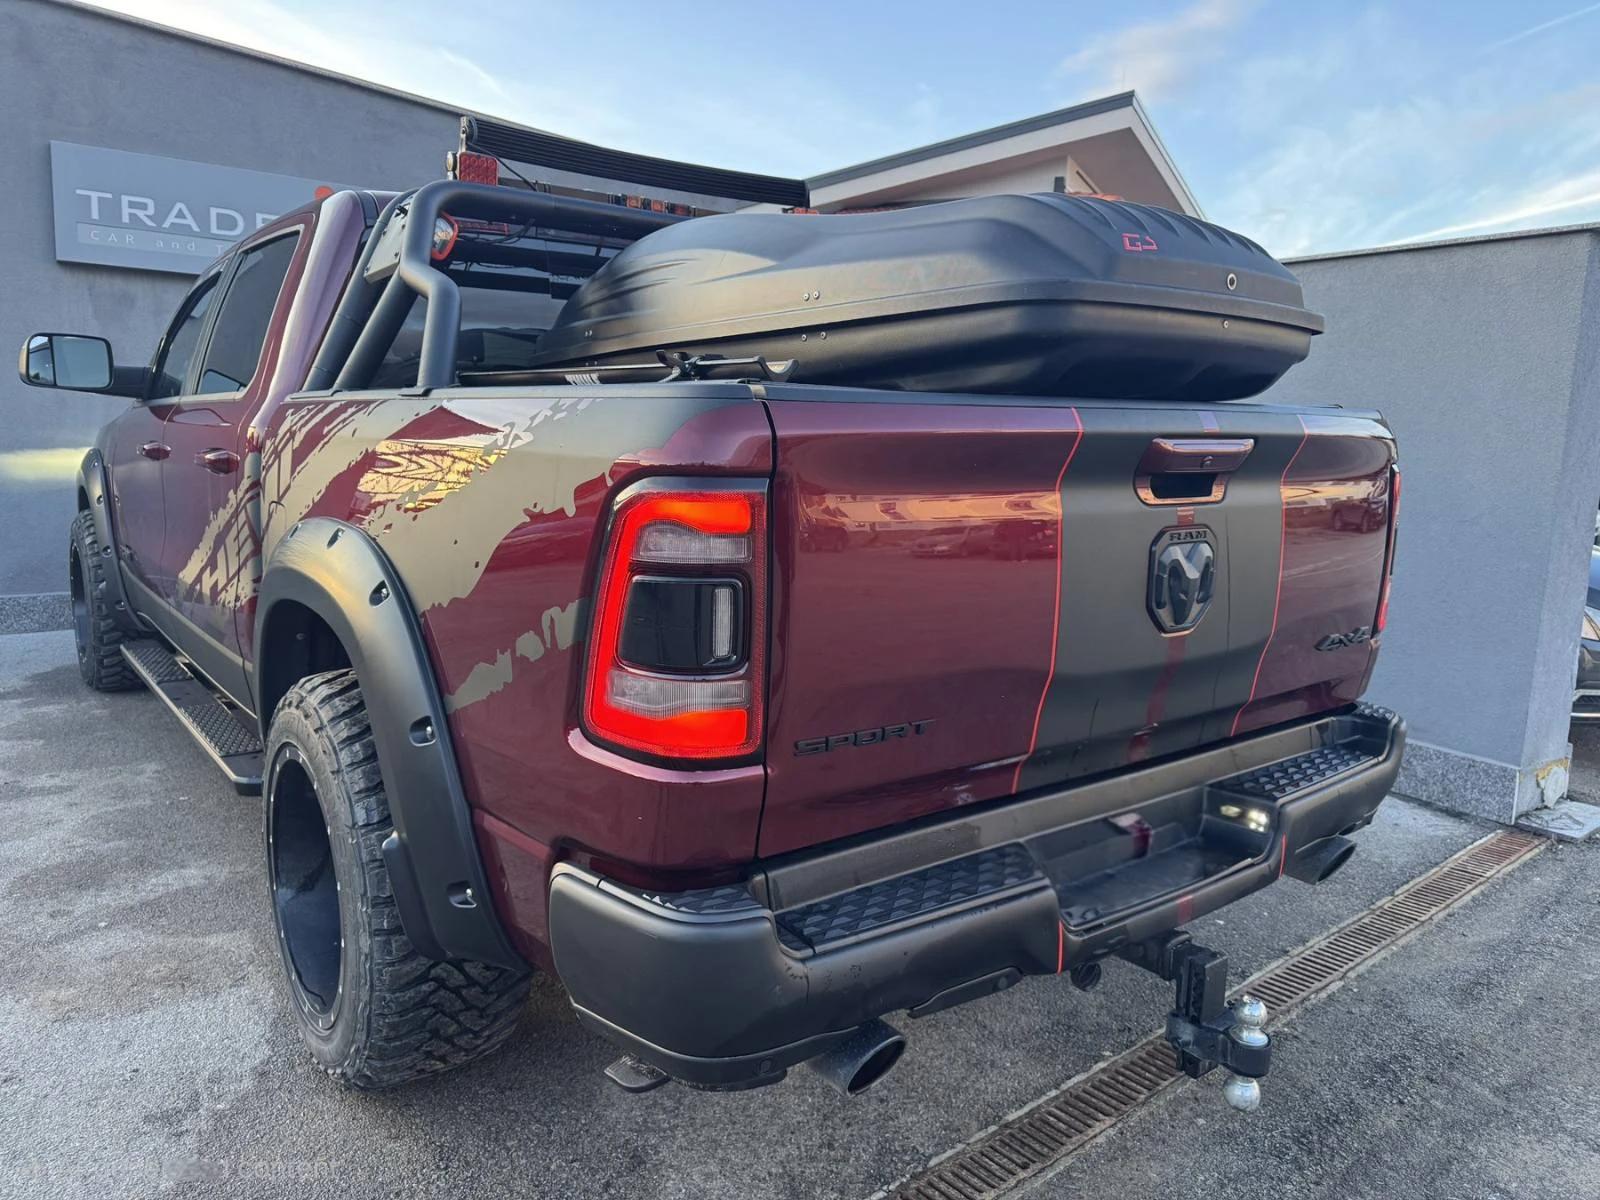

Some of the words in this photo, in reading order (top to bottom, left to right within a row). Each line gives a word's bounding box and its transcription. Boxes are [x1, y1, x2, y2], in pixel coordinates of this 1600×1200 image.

[90, 230, 135, 245] CAR
[156, 239, 196, 251] and
[1168, 530, 1207, 541] RAM
[793, 719, 936, 757] SPORT
